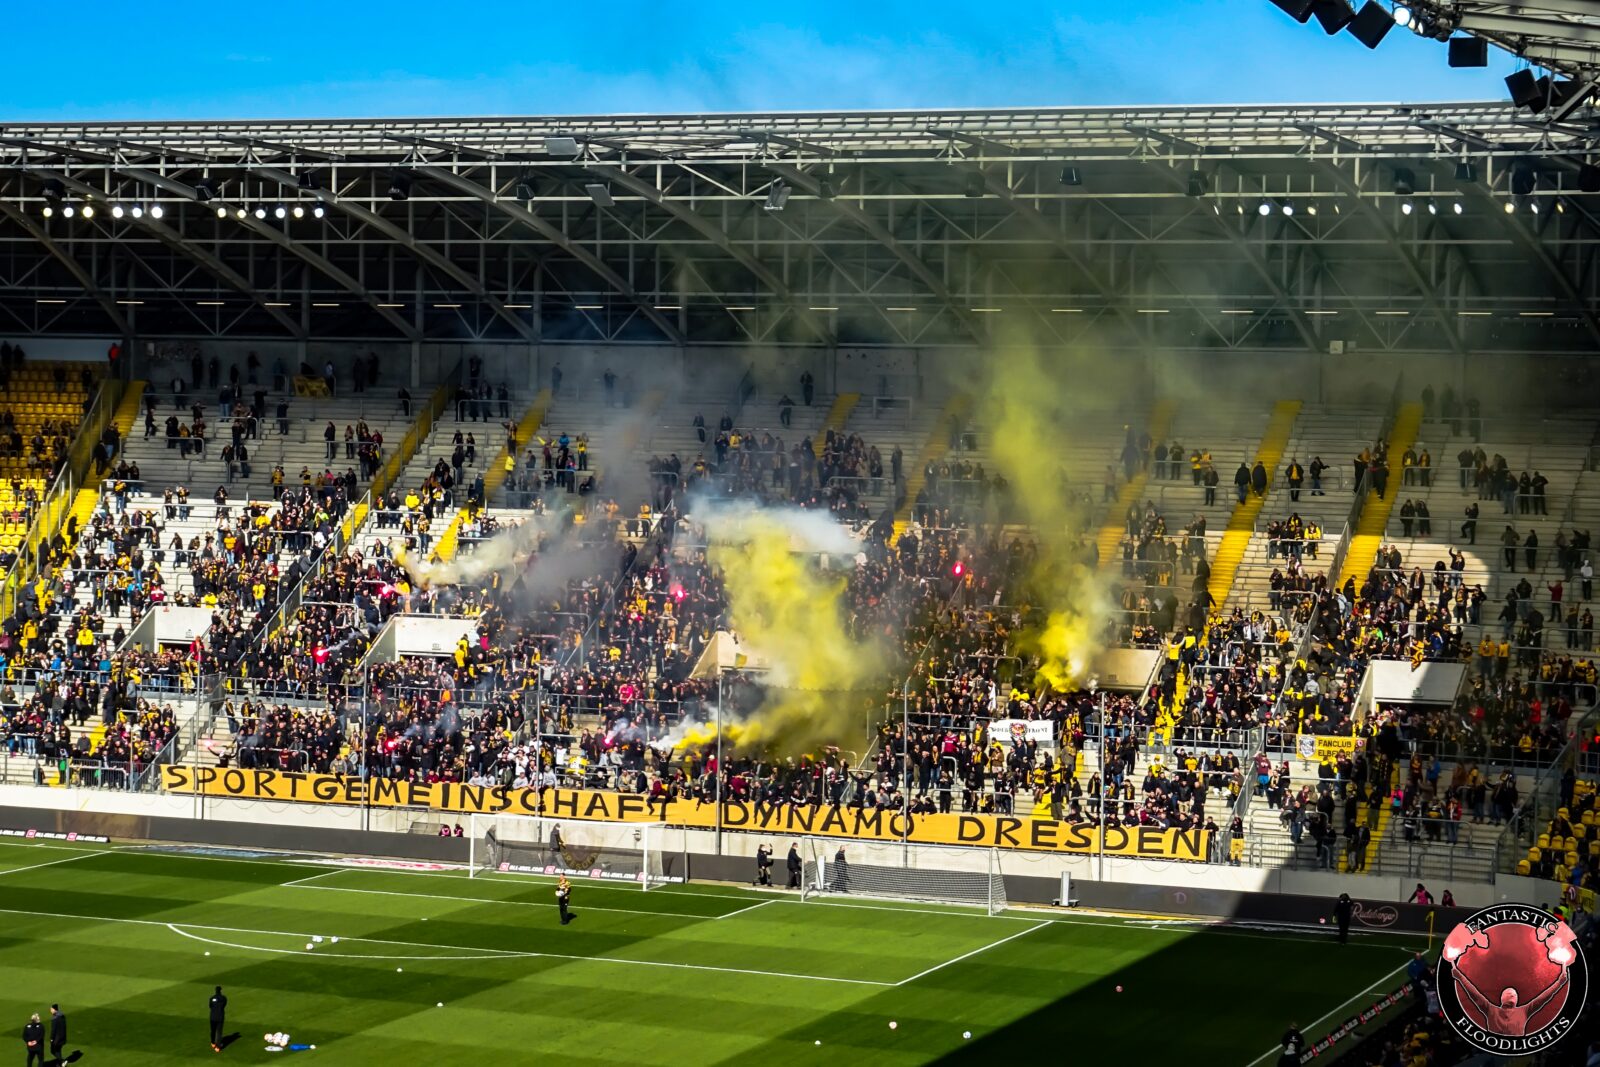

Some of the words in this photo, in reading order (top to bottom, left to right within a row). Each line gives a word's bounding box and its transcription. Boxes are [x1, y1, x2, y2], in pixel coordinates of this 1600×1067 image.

[1318, 739, 1352, 748] FANCLUB
[166, 765, 678, 821] SPORTGEMEINSCHAFT
[722, 801, 914, 837] DYNAMO
[957, 816, 1202, 857] DRESDEN
